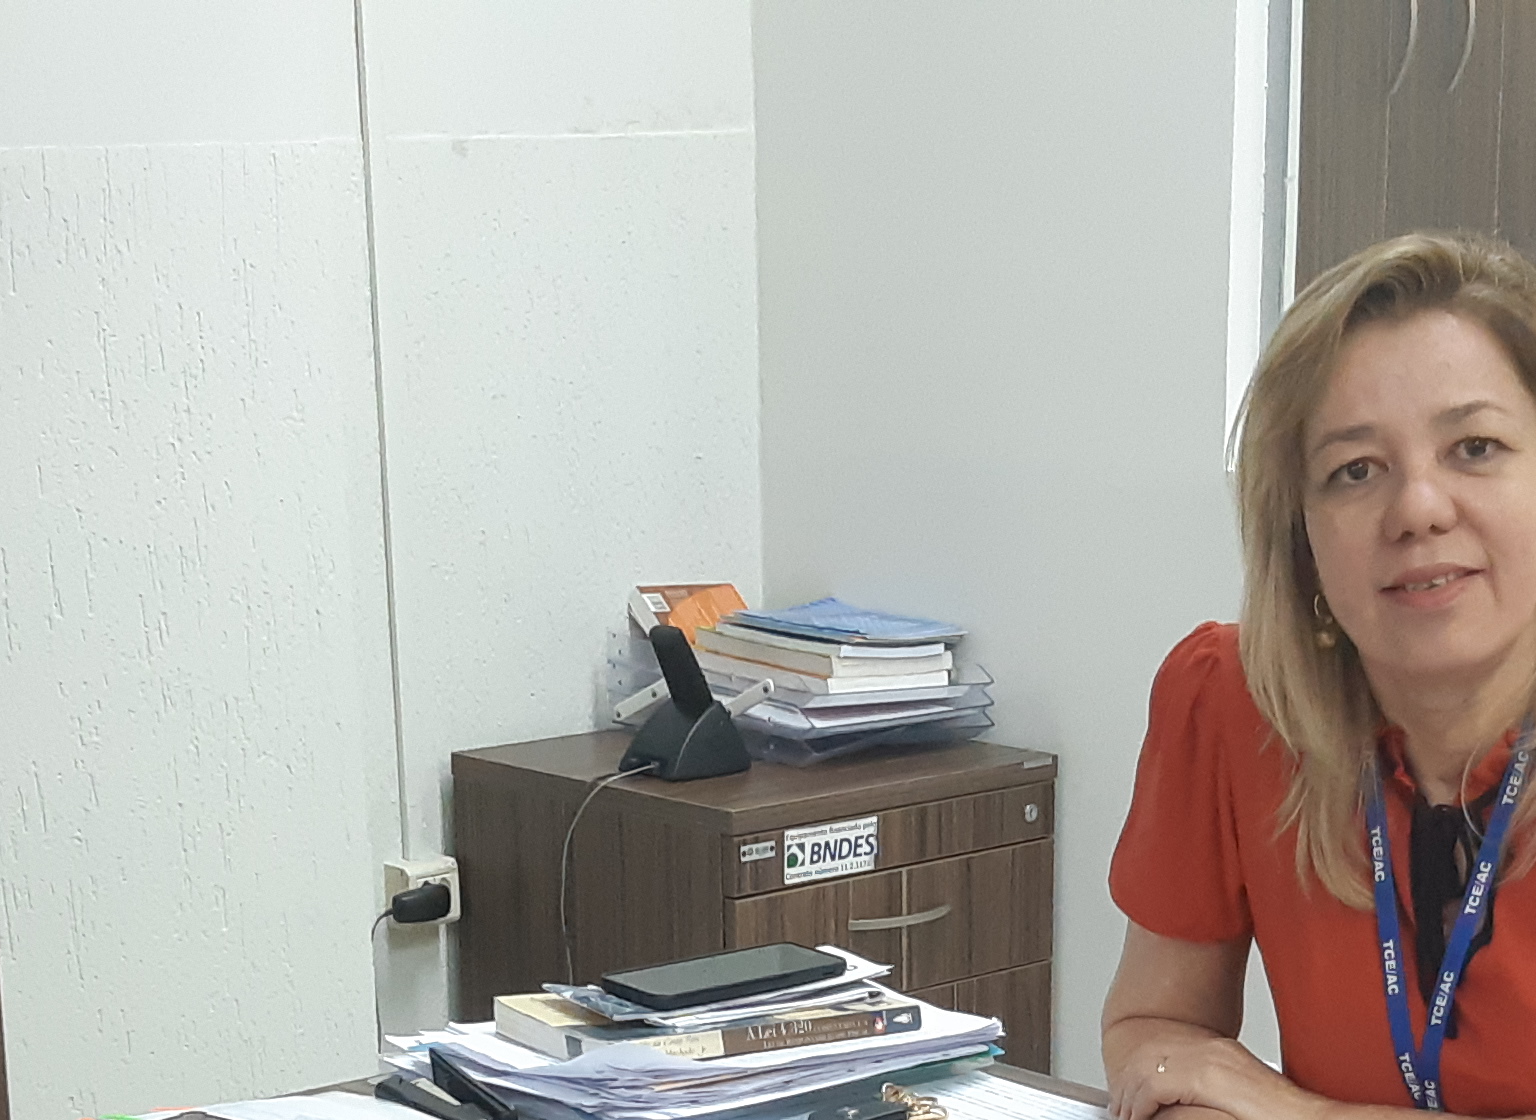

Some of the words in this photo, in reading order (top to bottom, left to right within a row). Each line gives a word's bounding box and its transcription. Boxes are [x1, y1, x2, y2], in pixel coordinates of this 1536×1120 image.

[1502, 751, 1529, 805] TCE/AC
[809, 834, 876, 865] BNDES
[1370, 826, 1385, 883] TCE/AC
[1463, 861, 1492, 915] TCE/AC
[1382, 939, 1399, 995] TCE/AC
[1430, 970, 1454, 1026] TCE/AC
